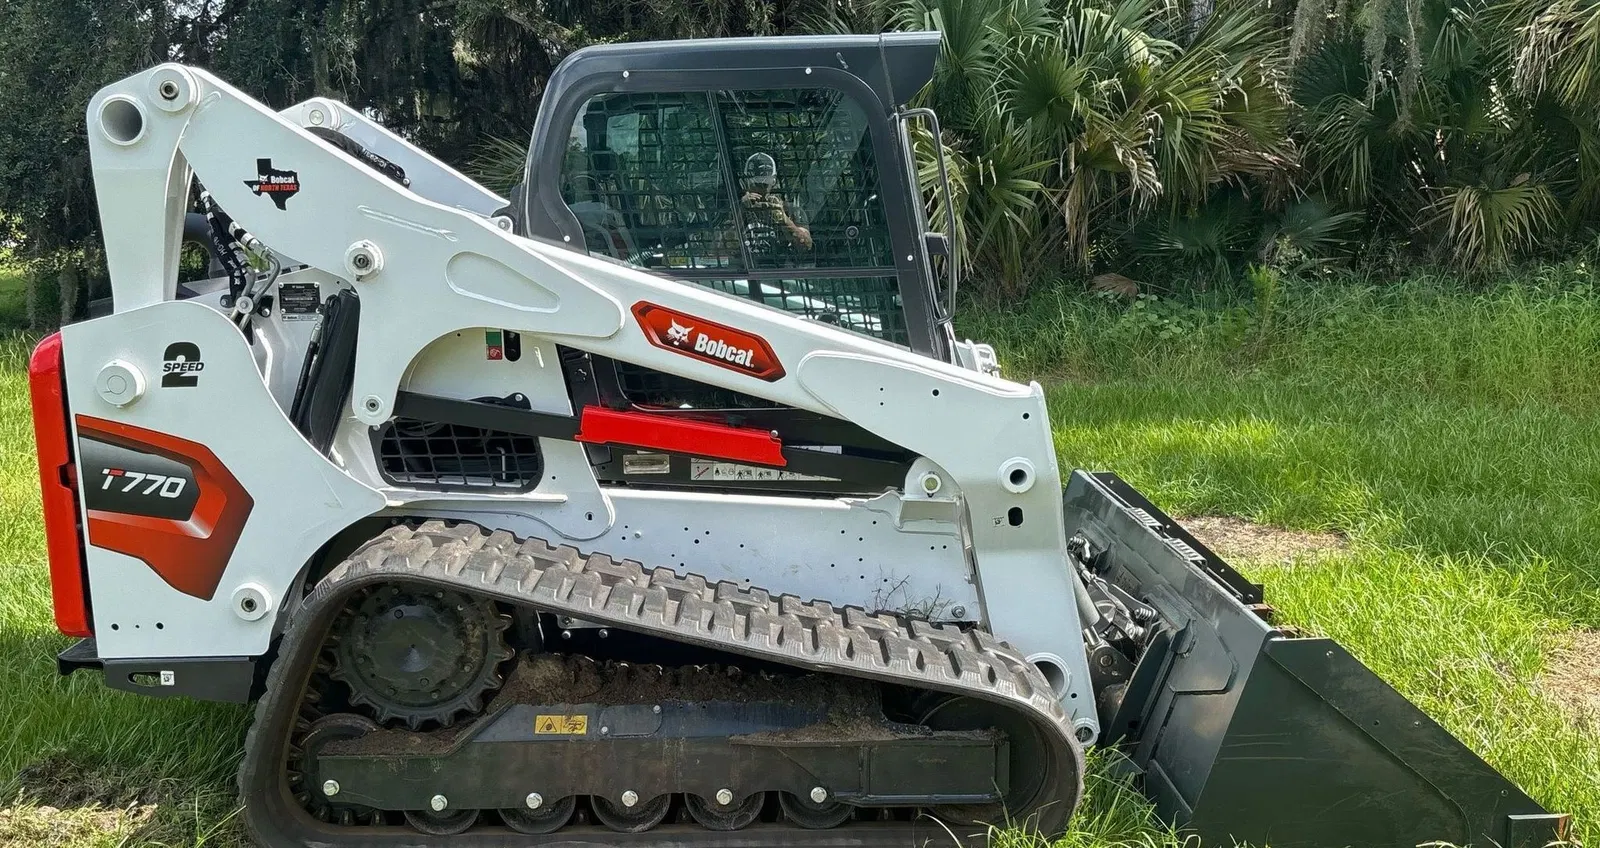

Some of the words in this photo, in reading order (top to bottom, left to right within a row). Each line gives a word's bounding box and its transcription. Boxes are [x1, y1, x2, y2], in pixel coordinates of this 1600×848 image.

[270, 175, 295, 184] Bobcat
[161, 341, 201, 388] 2
[694, 332, 754, 368] Bobcat
[162, 362, 205, 372] SPEED
[101, 468, 187, 498] T770
